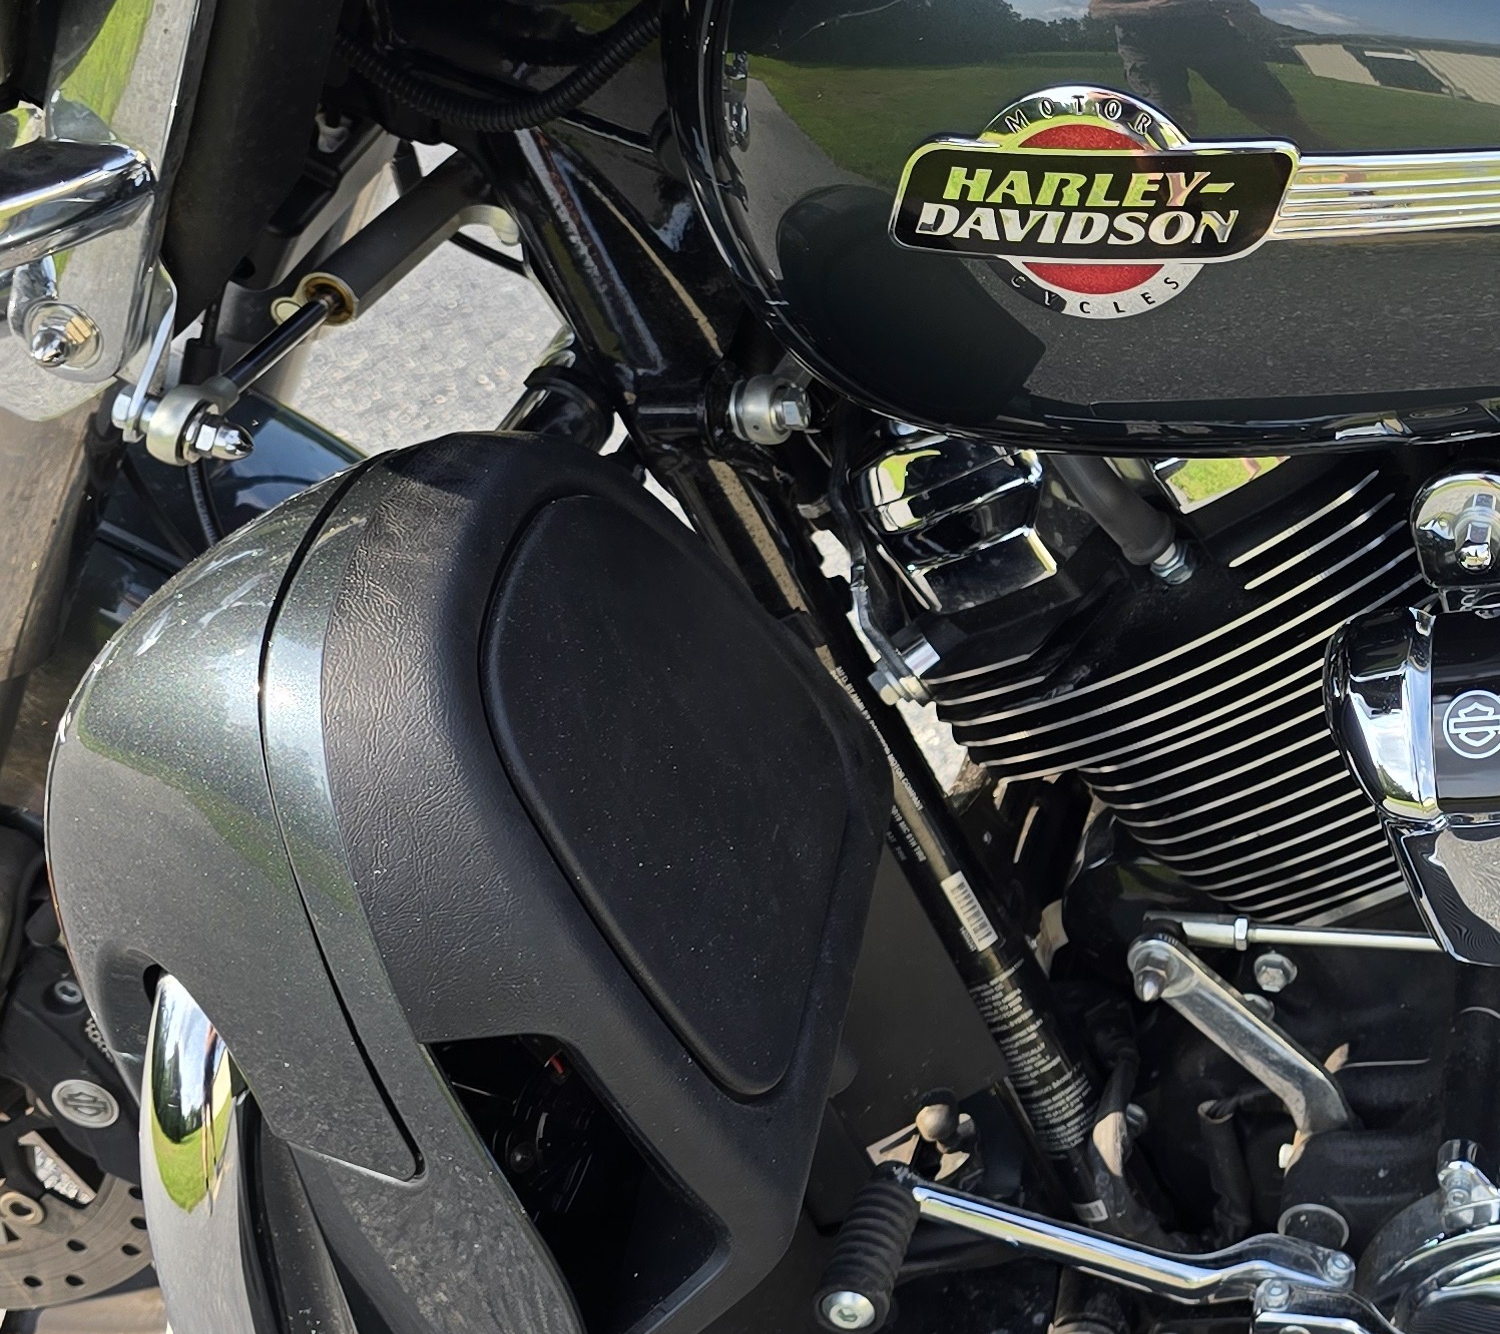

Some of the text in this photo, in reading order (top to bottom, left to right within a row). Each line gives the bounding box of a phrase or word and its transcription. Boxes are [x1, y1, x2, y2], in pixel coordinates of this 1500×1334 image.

[1004, 94, 1152, 135] MOTOR
[942, 166, 1235, 207] HARLEY-
[915, 202, 1239, 245] DAVIDSON
[1010, 273, 1181, 315] CYCLES
